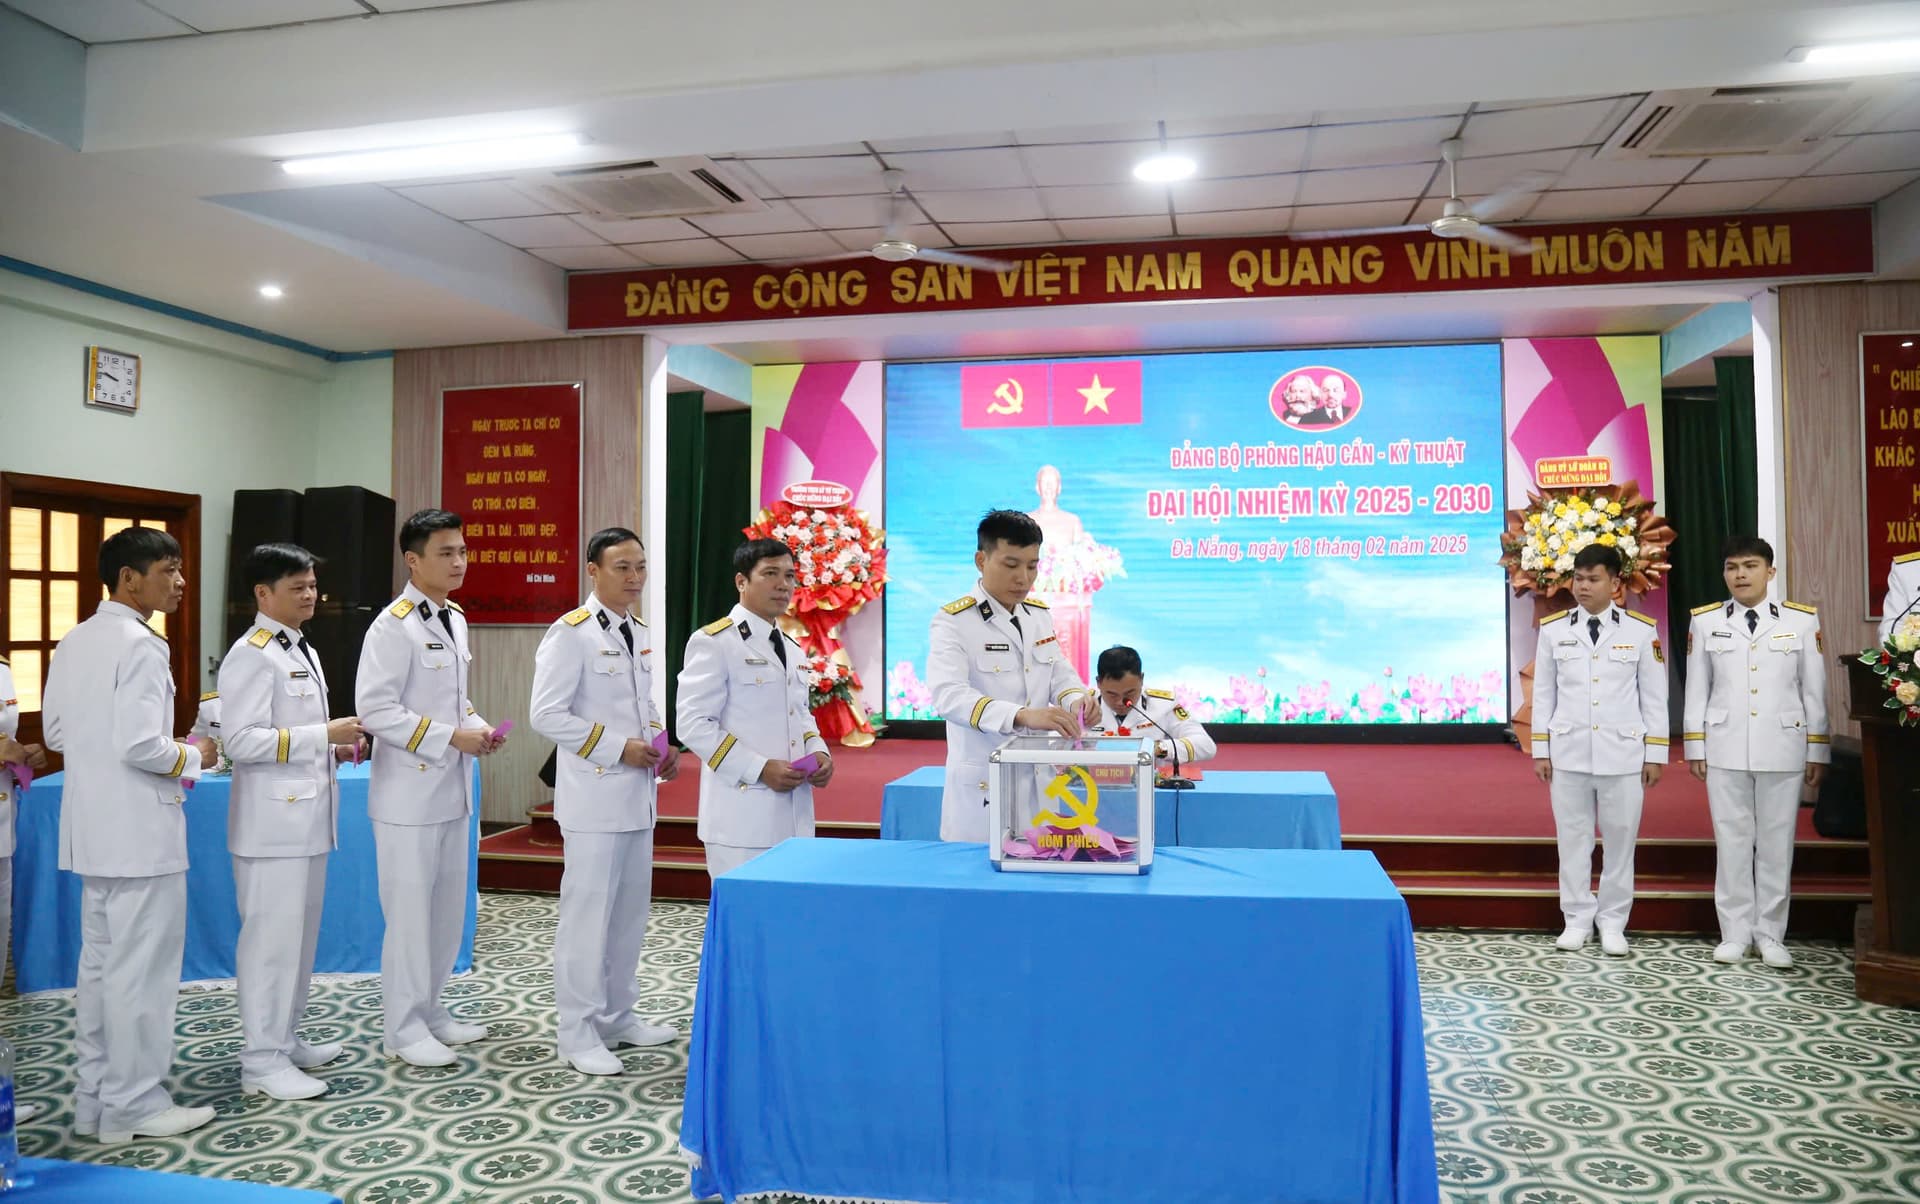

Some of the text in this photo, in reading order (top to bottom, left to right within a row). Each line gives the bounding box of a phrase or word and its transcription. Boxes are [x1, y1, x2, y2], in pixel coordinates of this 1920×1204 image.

[625, 222, 1792, 317] ĐẢNG CỘNG SẢN VIỆT NAM QUANG VINH MUÔN NĂM
[522, 418, 531, 430] TA
[1172, 440, 1213, 467] ĐẢNG
[1219, 443, 1240, 471] BỘ
[1245, 442, 1299, 467] PHÒNG
[1304, 441, 1335, 469] HẬU
[1389, 441, 1411, 463] KỸ
[1415, 439, 1465, 467] THUẬT
[504, 471, 513, 484] TA
[1148, 490, 1185, 523] ĐẠI
[1193, 484, 1230, 523] HỘI
[1238, 482, 1311, 523] NHIỆM
[1319, 481, 1349, 514] KỲ
[1356, 487, 1411, 513] 2025
[1435, 485, 1492, 512] 2030
[487, 523, 496, 536] TA
[1171, 535, 1468, 561] Đà Nẵng, ngày 18 tháng 02 năm 2025
